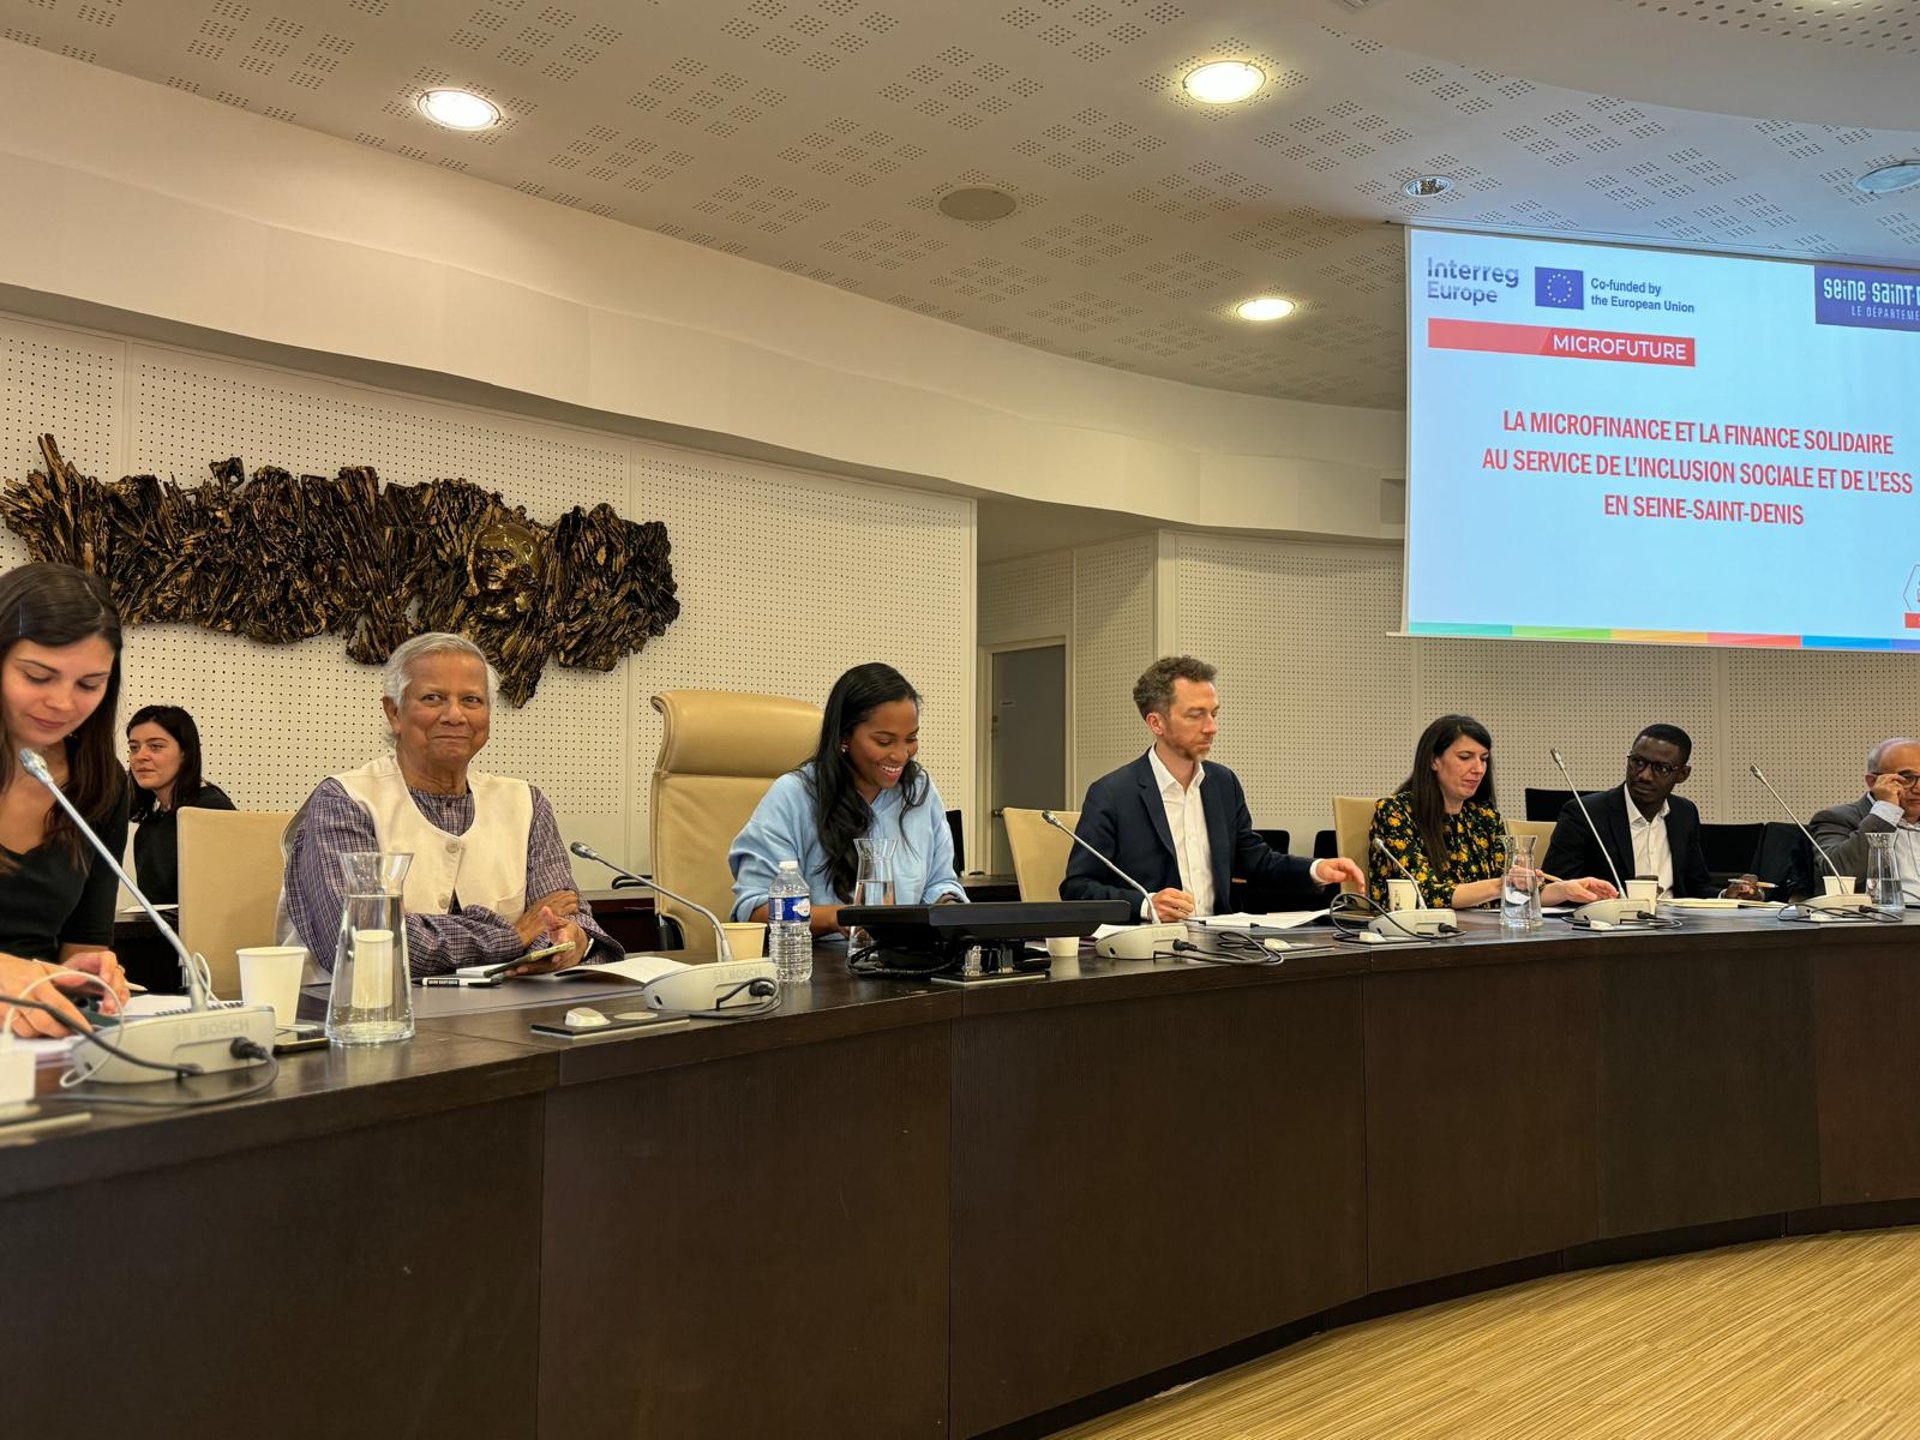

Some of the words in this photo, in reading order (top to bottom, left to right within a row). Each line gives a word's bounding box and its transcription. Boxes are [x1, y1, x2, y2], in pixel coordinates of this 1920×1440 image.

[1427, 257, 1519, 288] Interreg
[1427, 281, 1498, 306] Europe
[1591, 278, 1645, 293] Co-funded
[1648, 282, 1661, 297] by
[1591, 294, 1608, 306] the
[1611, 296, 1661, 311] European
[1664, 300, 1695, 313] Union
[1851, 305, 1862, 317] LE
[1553, 334, 1688, 360] MICROFUTURE
[1503, 410, 1526, 431] LA
[1530, 412, 1671, 440] MICROFINANCE
[1675, 421, 1695, 442] ET
[1699, 423, 1720, 444] LA
[1724, 425, 1800, 448] FINANCE
[1804, 429, 1894, 455] SOLIDAIRE
[1482, 448, 1508, 470] AU
[1513, 450, 1592, 474] SERVICE
[1596, 454, 1620, 476] DE
[1625, 456, 1735, 484] L’INCLUSION
[1740, 463, 1814, 488] SOCIALE
[1818, 468, 1837, 489] ET
[1841, 470, 1864, 491] DE
[1868, 471, 1913, 494] L’ESS
[1604, 494, 1628, 516] EN
[1633, 495, 1804, 525] SEINE-SAINT-DENIS
[198, 1018, 249, 1036] BOSCH
